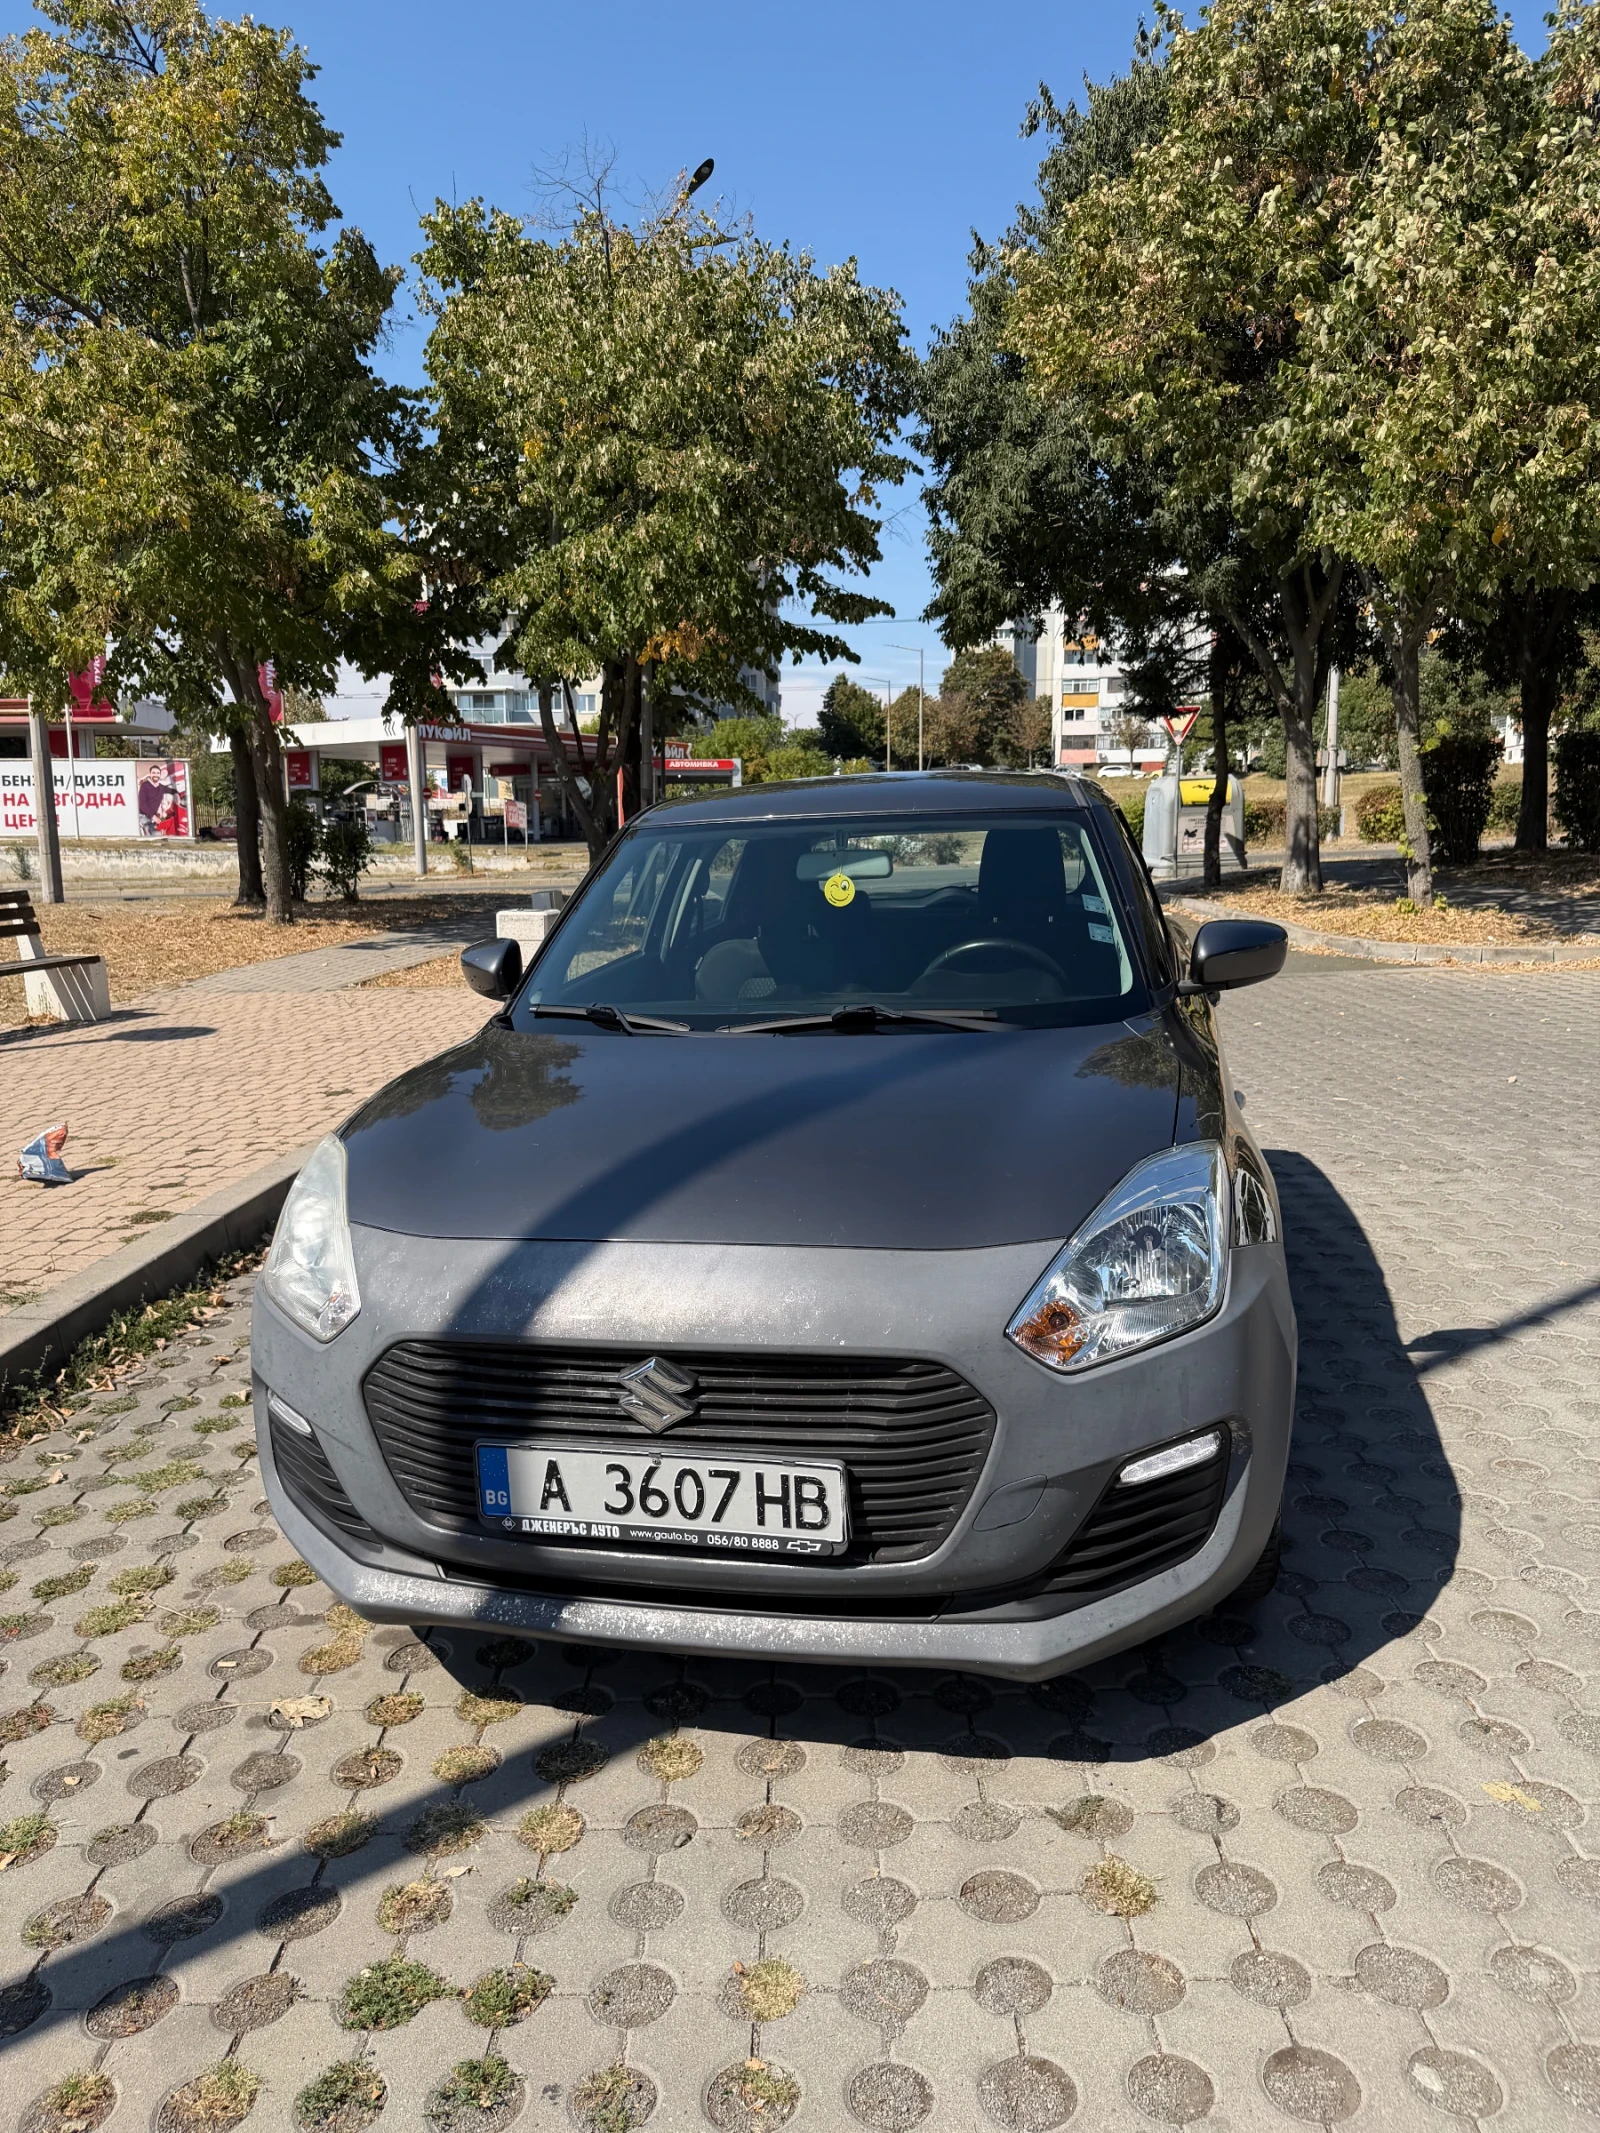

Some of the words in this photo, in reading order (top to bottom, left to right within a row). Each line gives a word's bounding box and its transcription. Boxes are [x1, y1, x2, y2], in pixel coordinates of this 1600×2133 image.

[669, 760, 718, 768] АВТОМИВКА
[3, 793, 30, 807] НА
[53, 793, 126, 809] ЗГОДНА
[485, 1490, 508, 1506] BG
[604, 1463, 741, 1523] 3607
[754, 1471, 832, 1530] HB
[521, 1519, 587, 1536] ДЖЕНЕРЪС
[591, 1524, 620, 1538] АУТО
[629, 1529, 698, 1543] www.gauto.bg
[707, 1534, 748, 1547] 056/80
[751, 1537, 779, 1549] 8888
